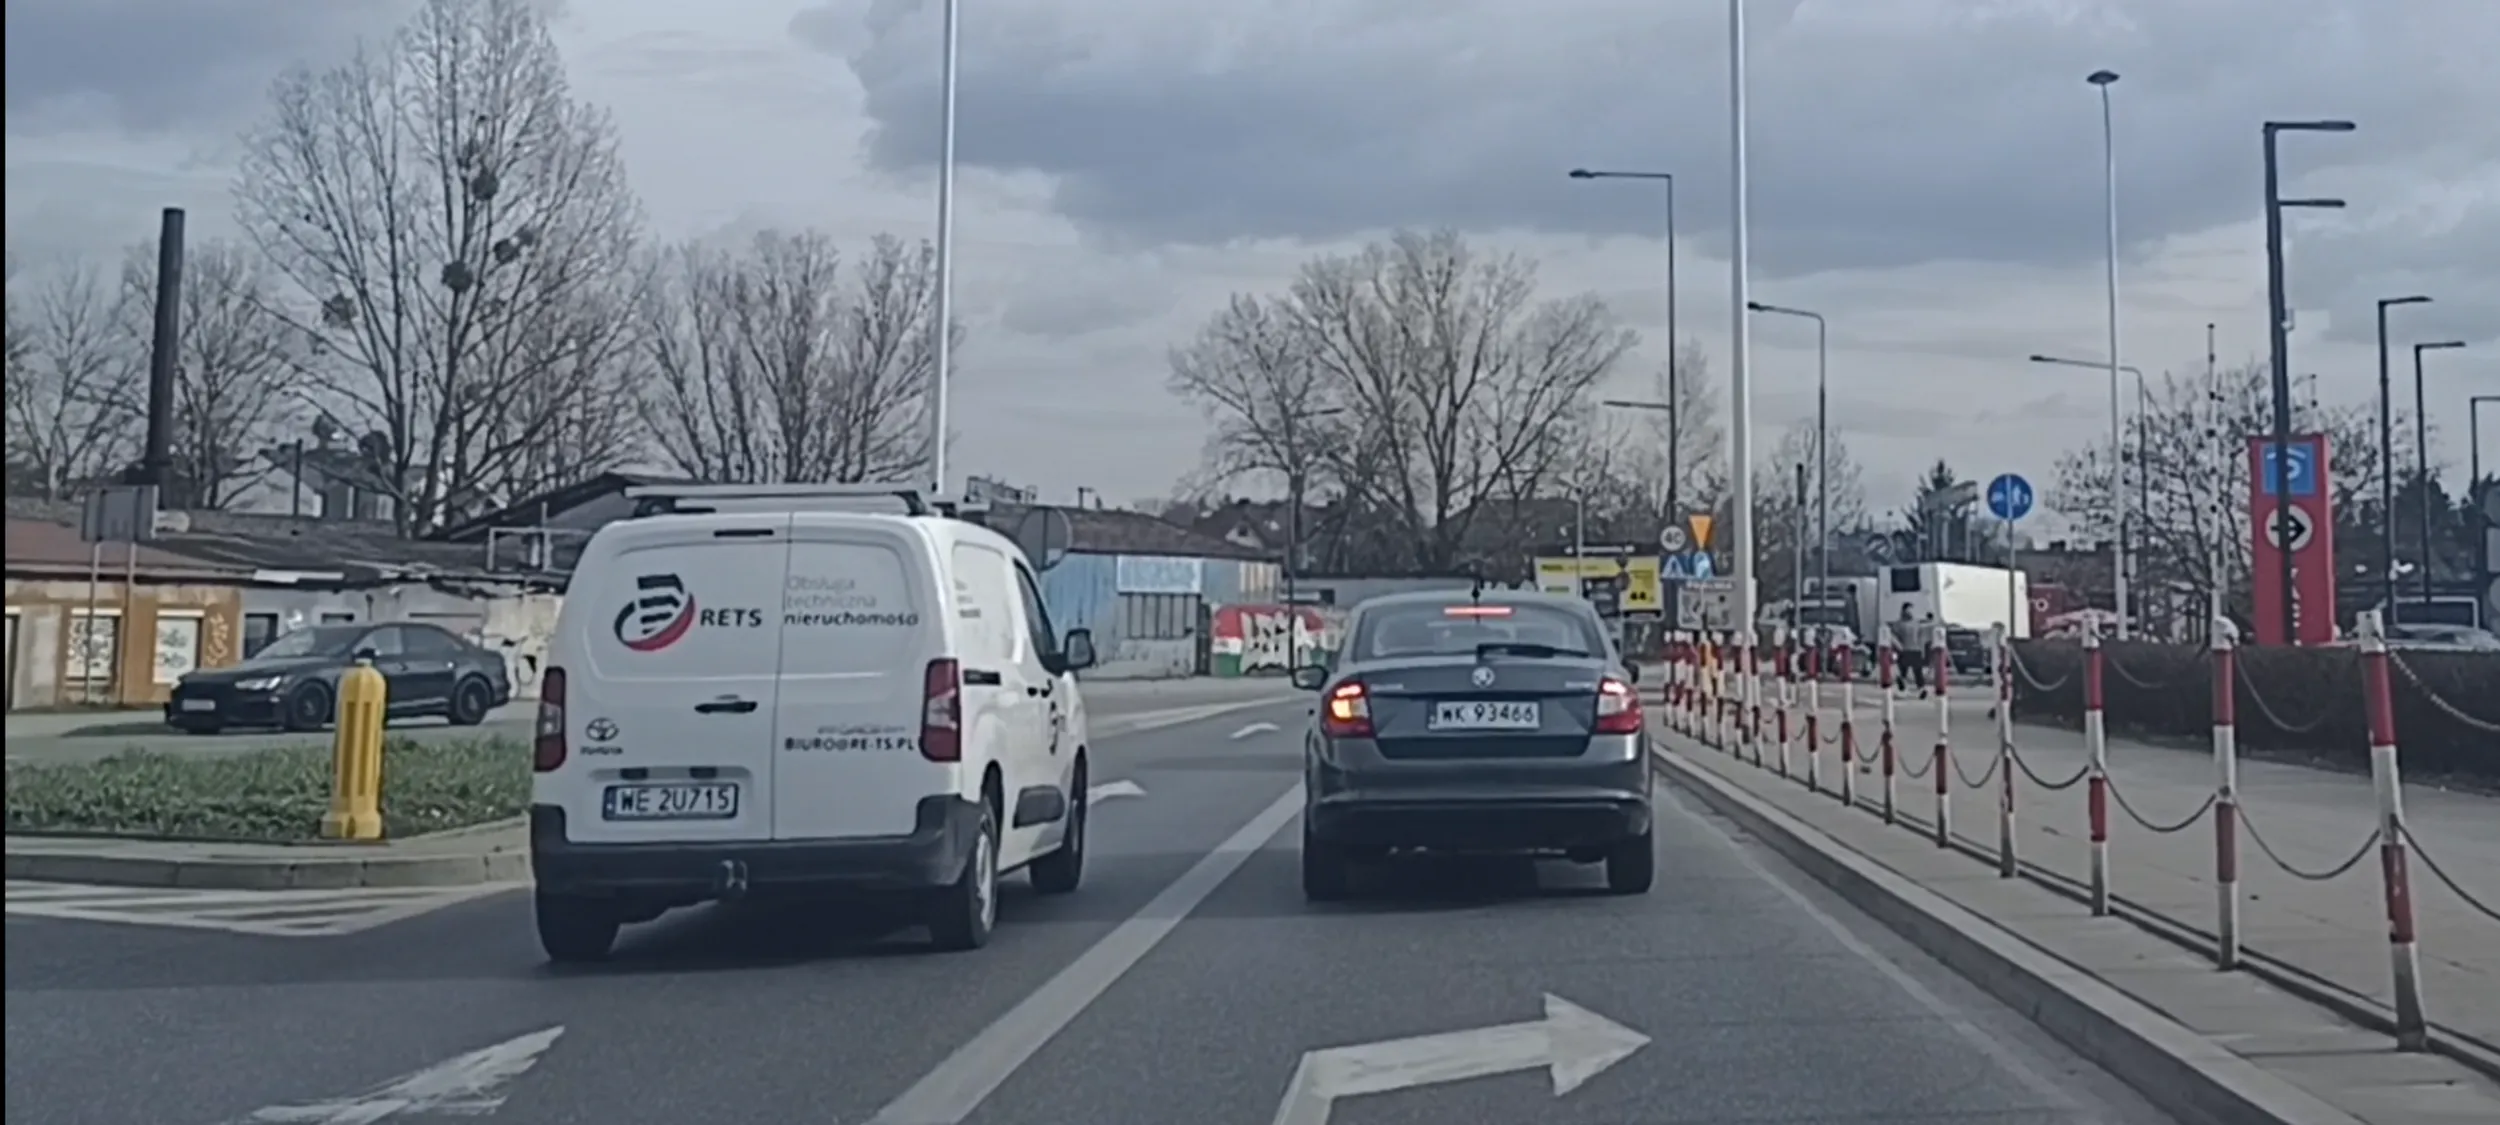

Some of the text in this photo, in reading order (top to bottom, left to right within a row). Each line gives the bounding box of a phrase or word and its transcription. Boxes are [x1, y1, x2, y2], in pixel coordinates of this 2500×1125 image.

[1664, 532, 1682, 545] 40
[700, 608, 763, 627] RETS
[1441, 704, 1535, 723] WK 93466
[621, 787, 730, 812] WE 2U715
